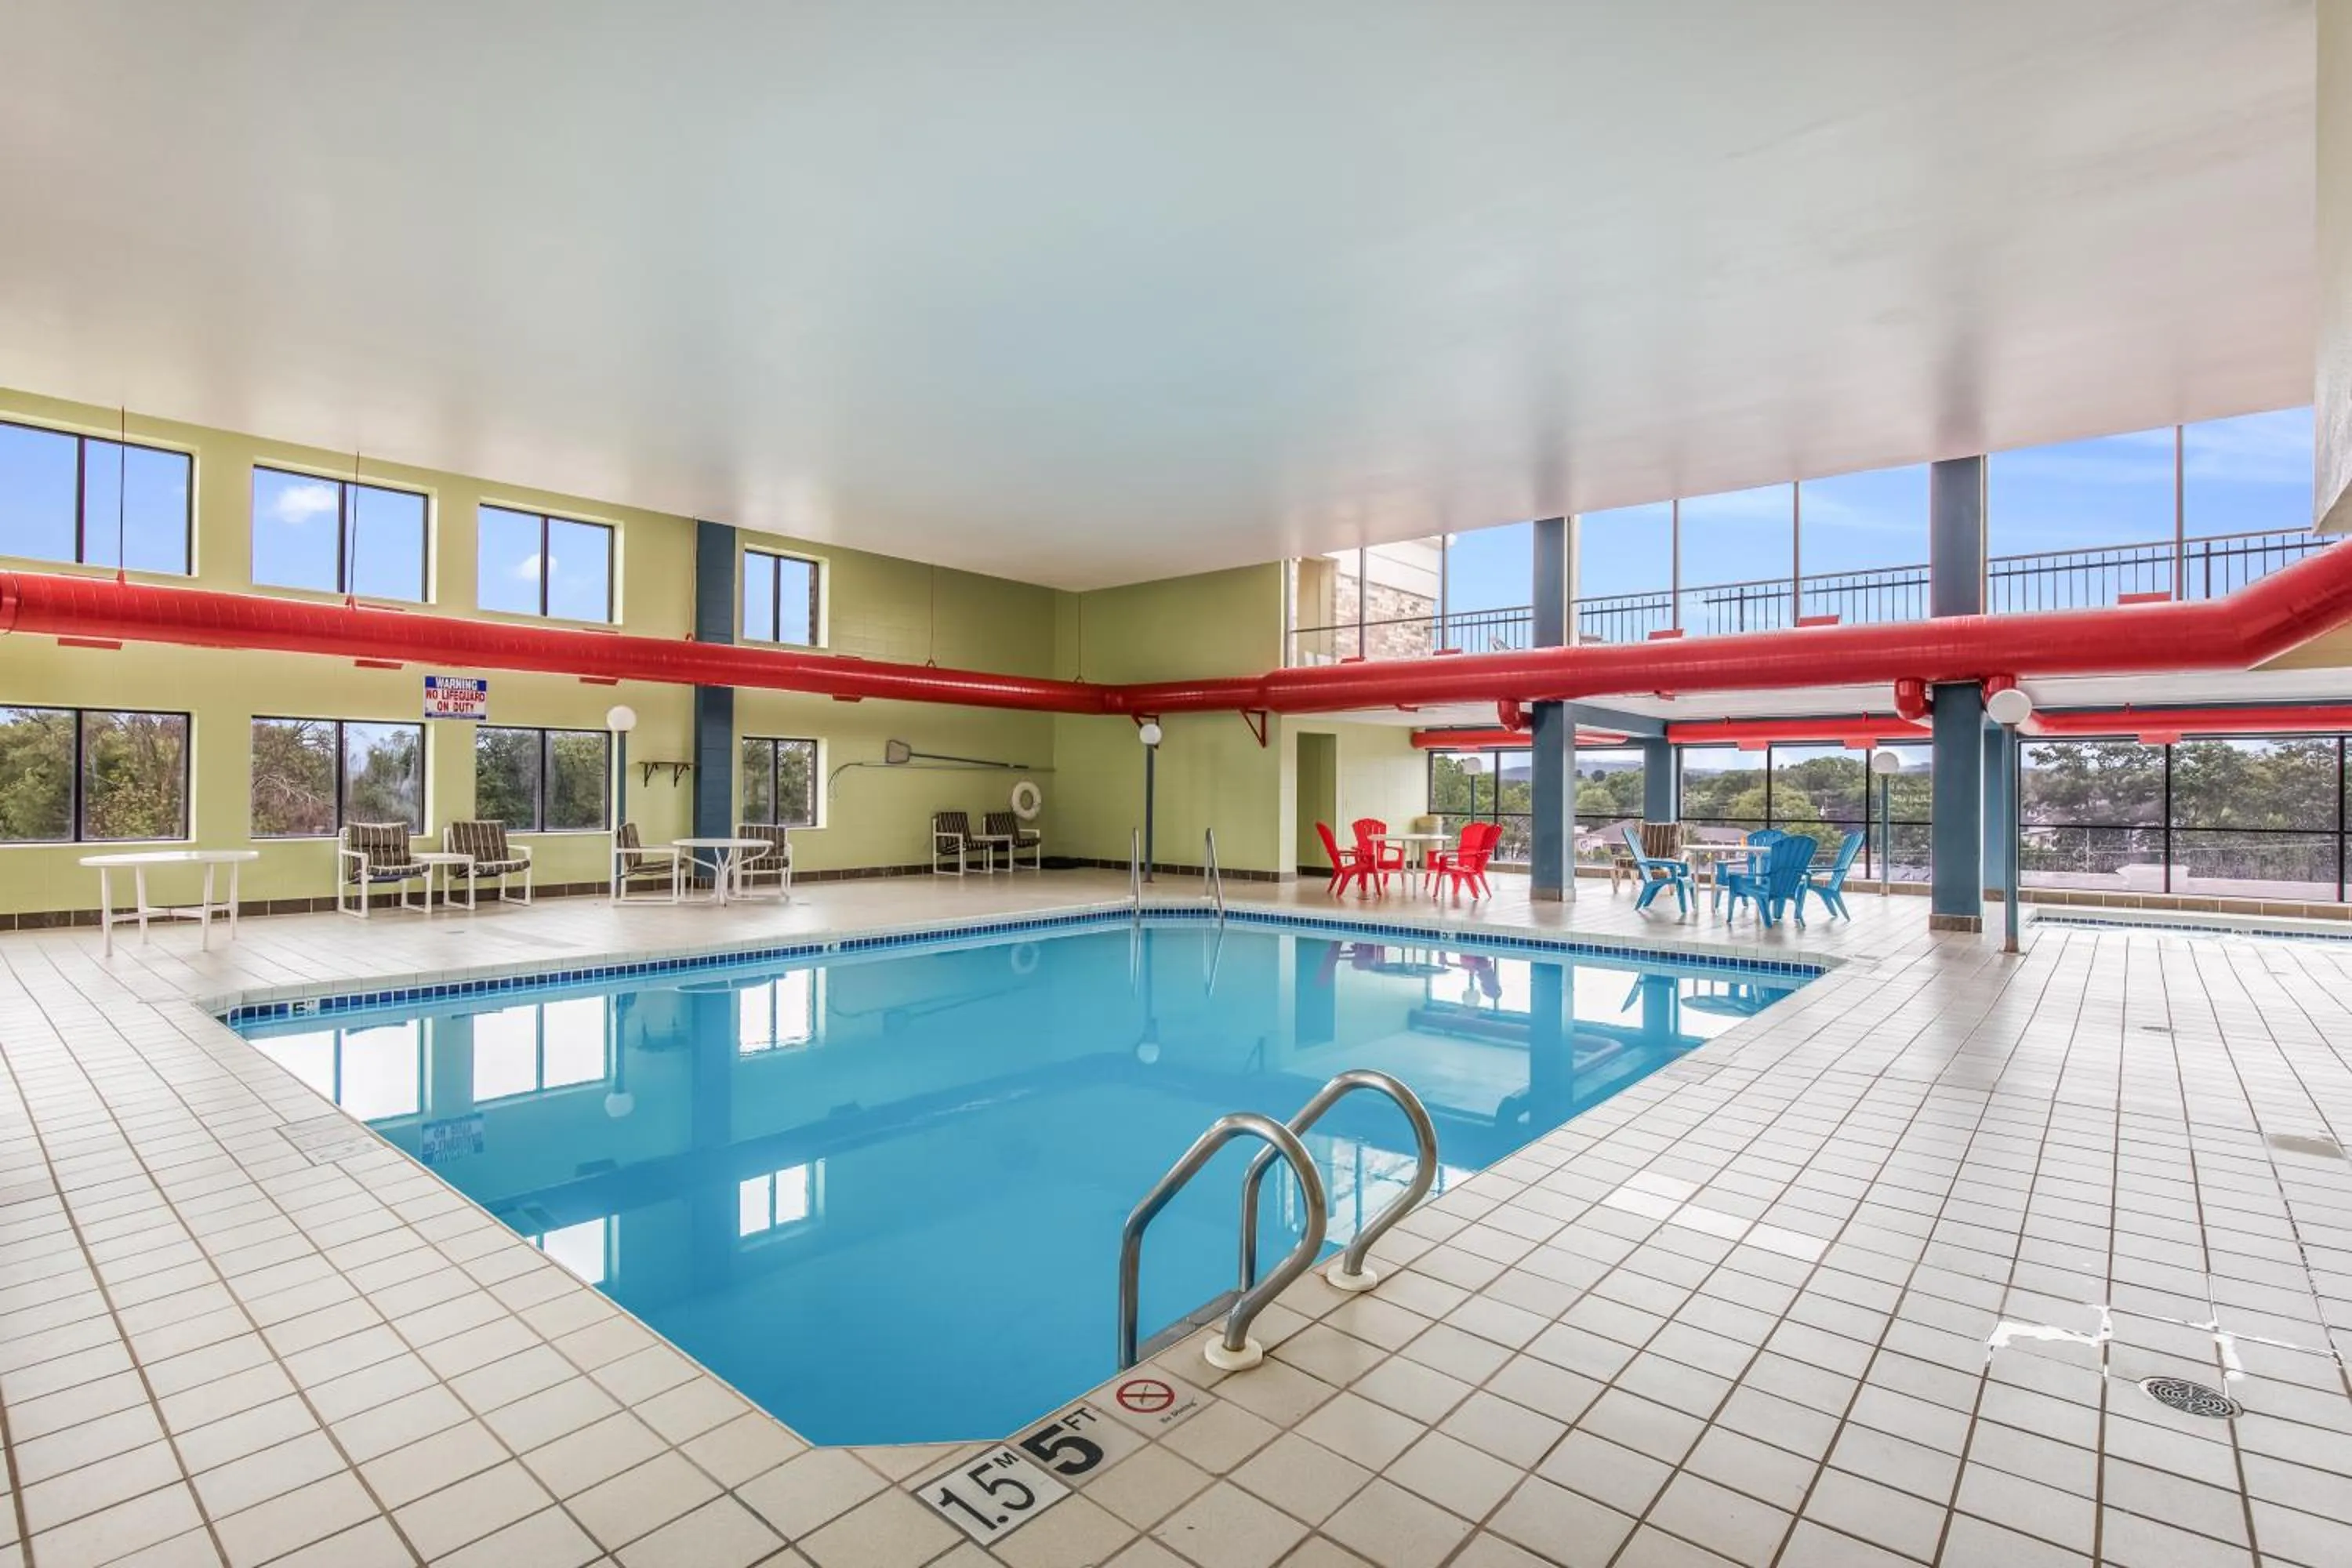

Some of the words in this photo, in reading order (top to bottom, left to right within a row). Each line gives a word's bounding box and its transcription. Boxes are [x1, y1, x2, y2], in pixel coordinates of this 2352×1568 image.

[435, 677, 477, 690] WARNING
[426, 689, 437, 699] NO
[441, 690, 485, 702] LIFEGUARD
[437, 701, 449, 711] ON
[453, 702, 474, 712] DUTY
[1061, 1408, 1097, 1431] FT
[1019, 1425, 1104, 1476] 5
